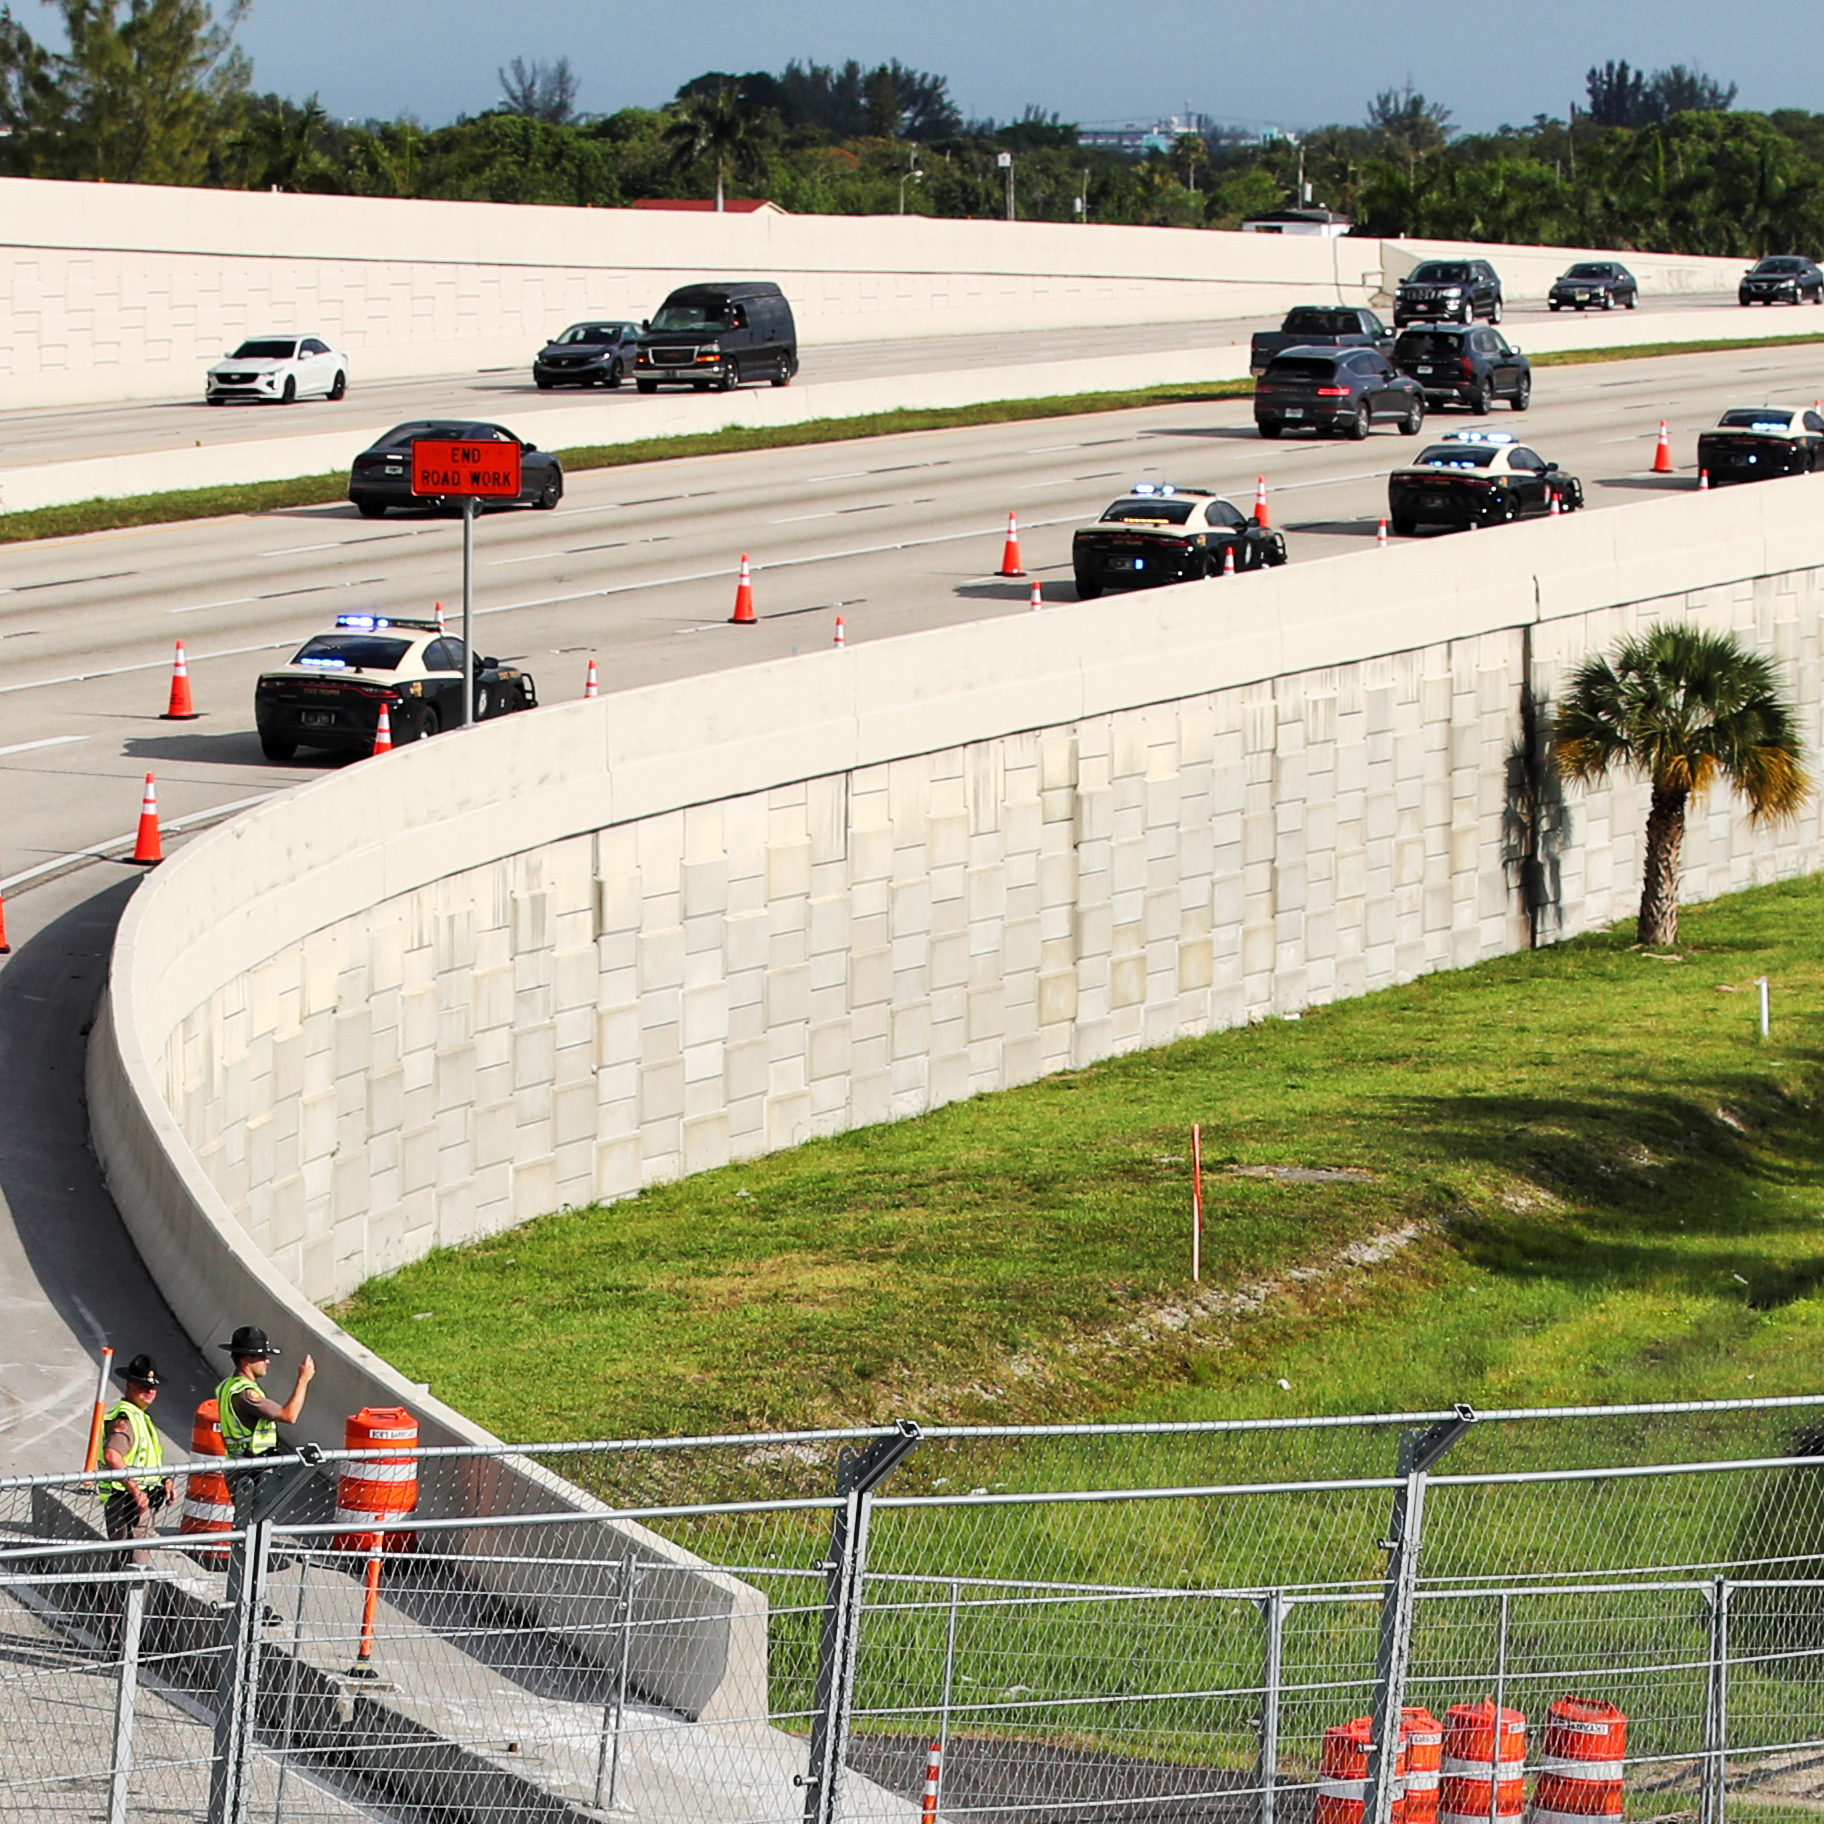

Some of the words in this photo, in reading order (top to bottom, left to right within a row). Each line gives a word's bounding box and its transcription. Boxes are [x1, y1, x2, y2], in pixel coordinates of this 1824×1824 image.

[451, 447, 481, 463] END
[422, 470, 461, 486] ROAD
[470, 471, 511, 486] WORK
